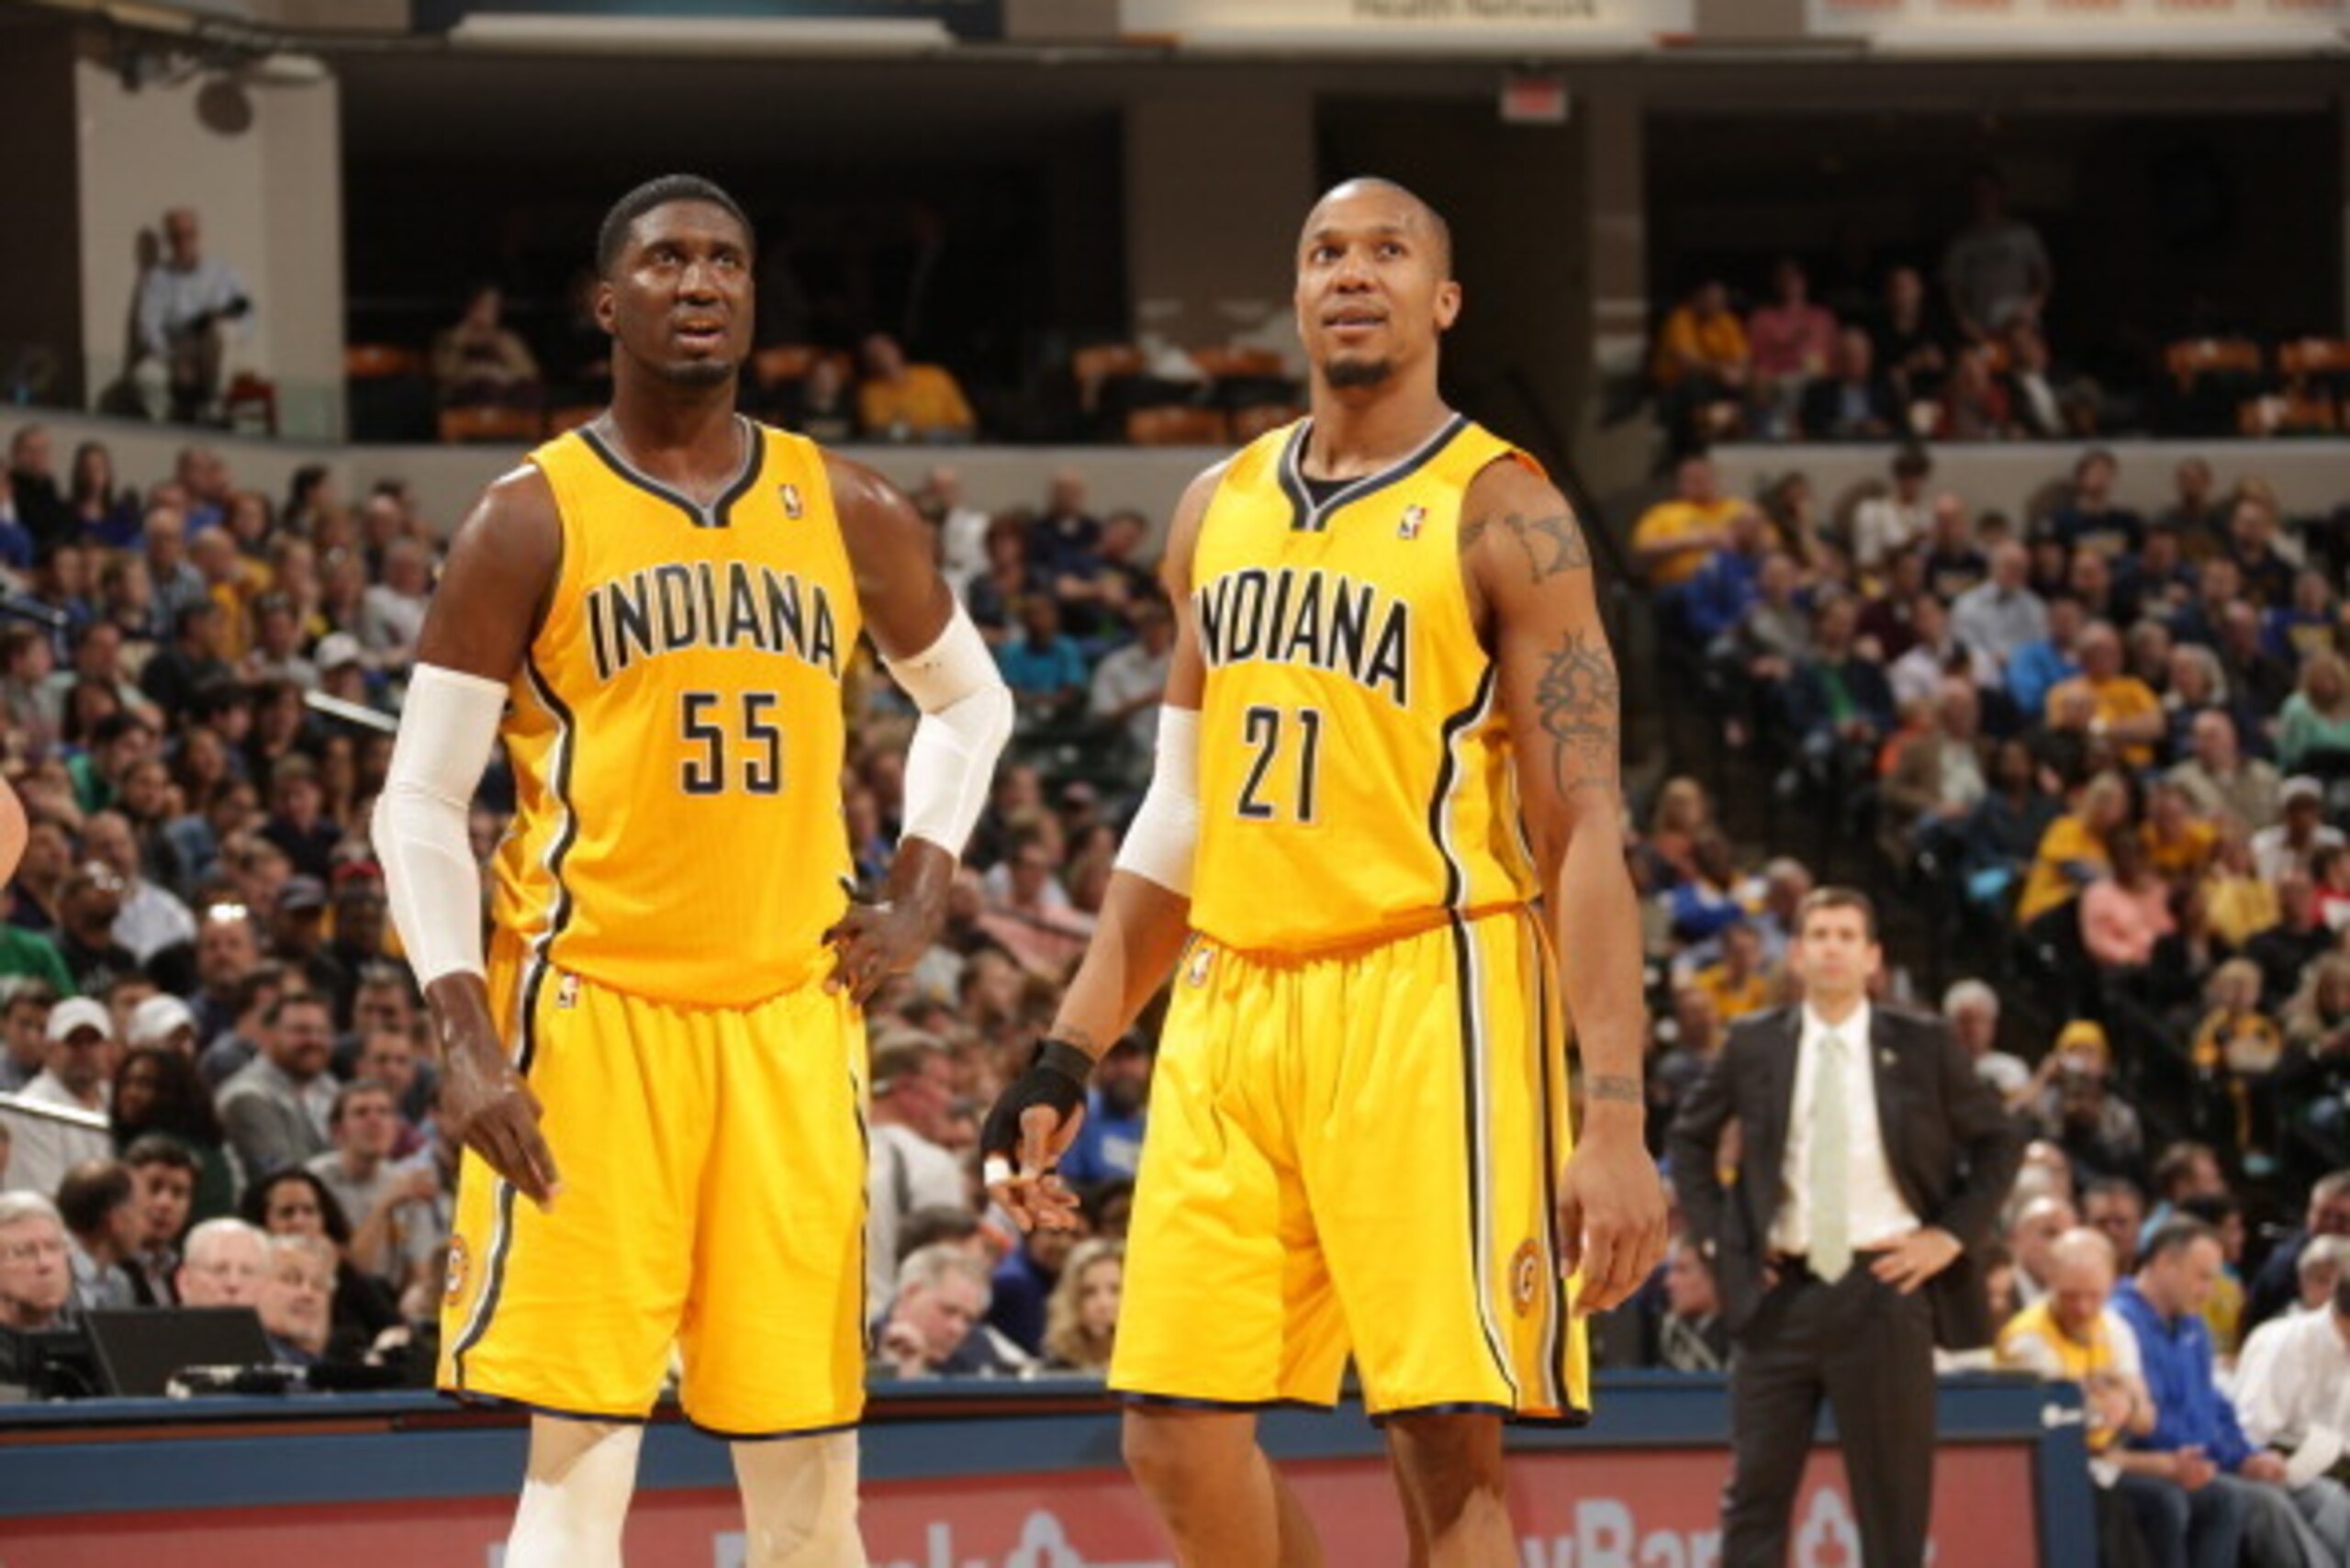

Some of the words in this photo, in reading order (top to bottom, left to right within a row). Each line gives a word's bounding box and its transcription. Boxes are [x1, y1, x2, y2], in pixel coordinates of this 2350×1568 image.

[587, 563, 839, 681] INDIANA
[1193, 566, 1410, 707] NDIANA
[679, 689, 782, 795] 55
[1236, 705, 1322, 822] 21
